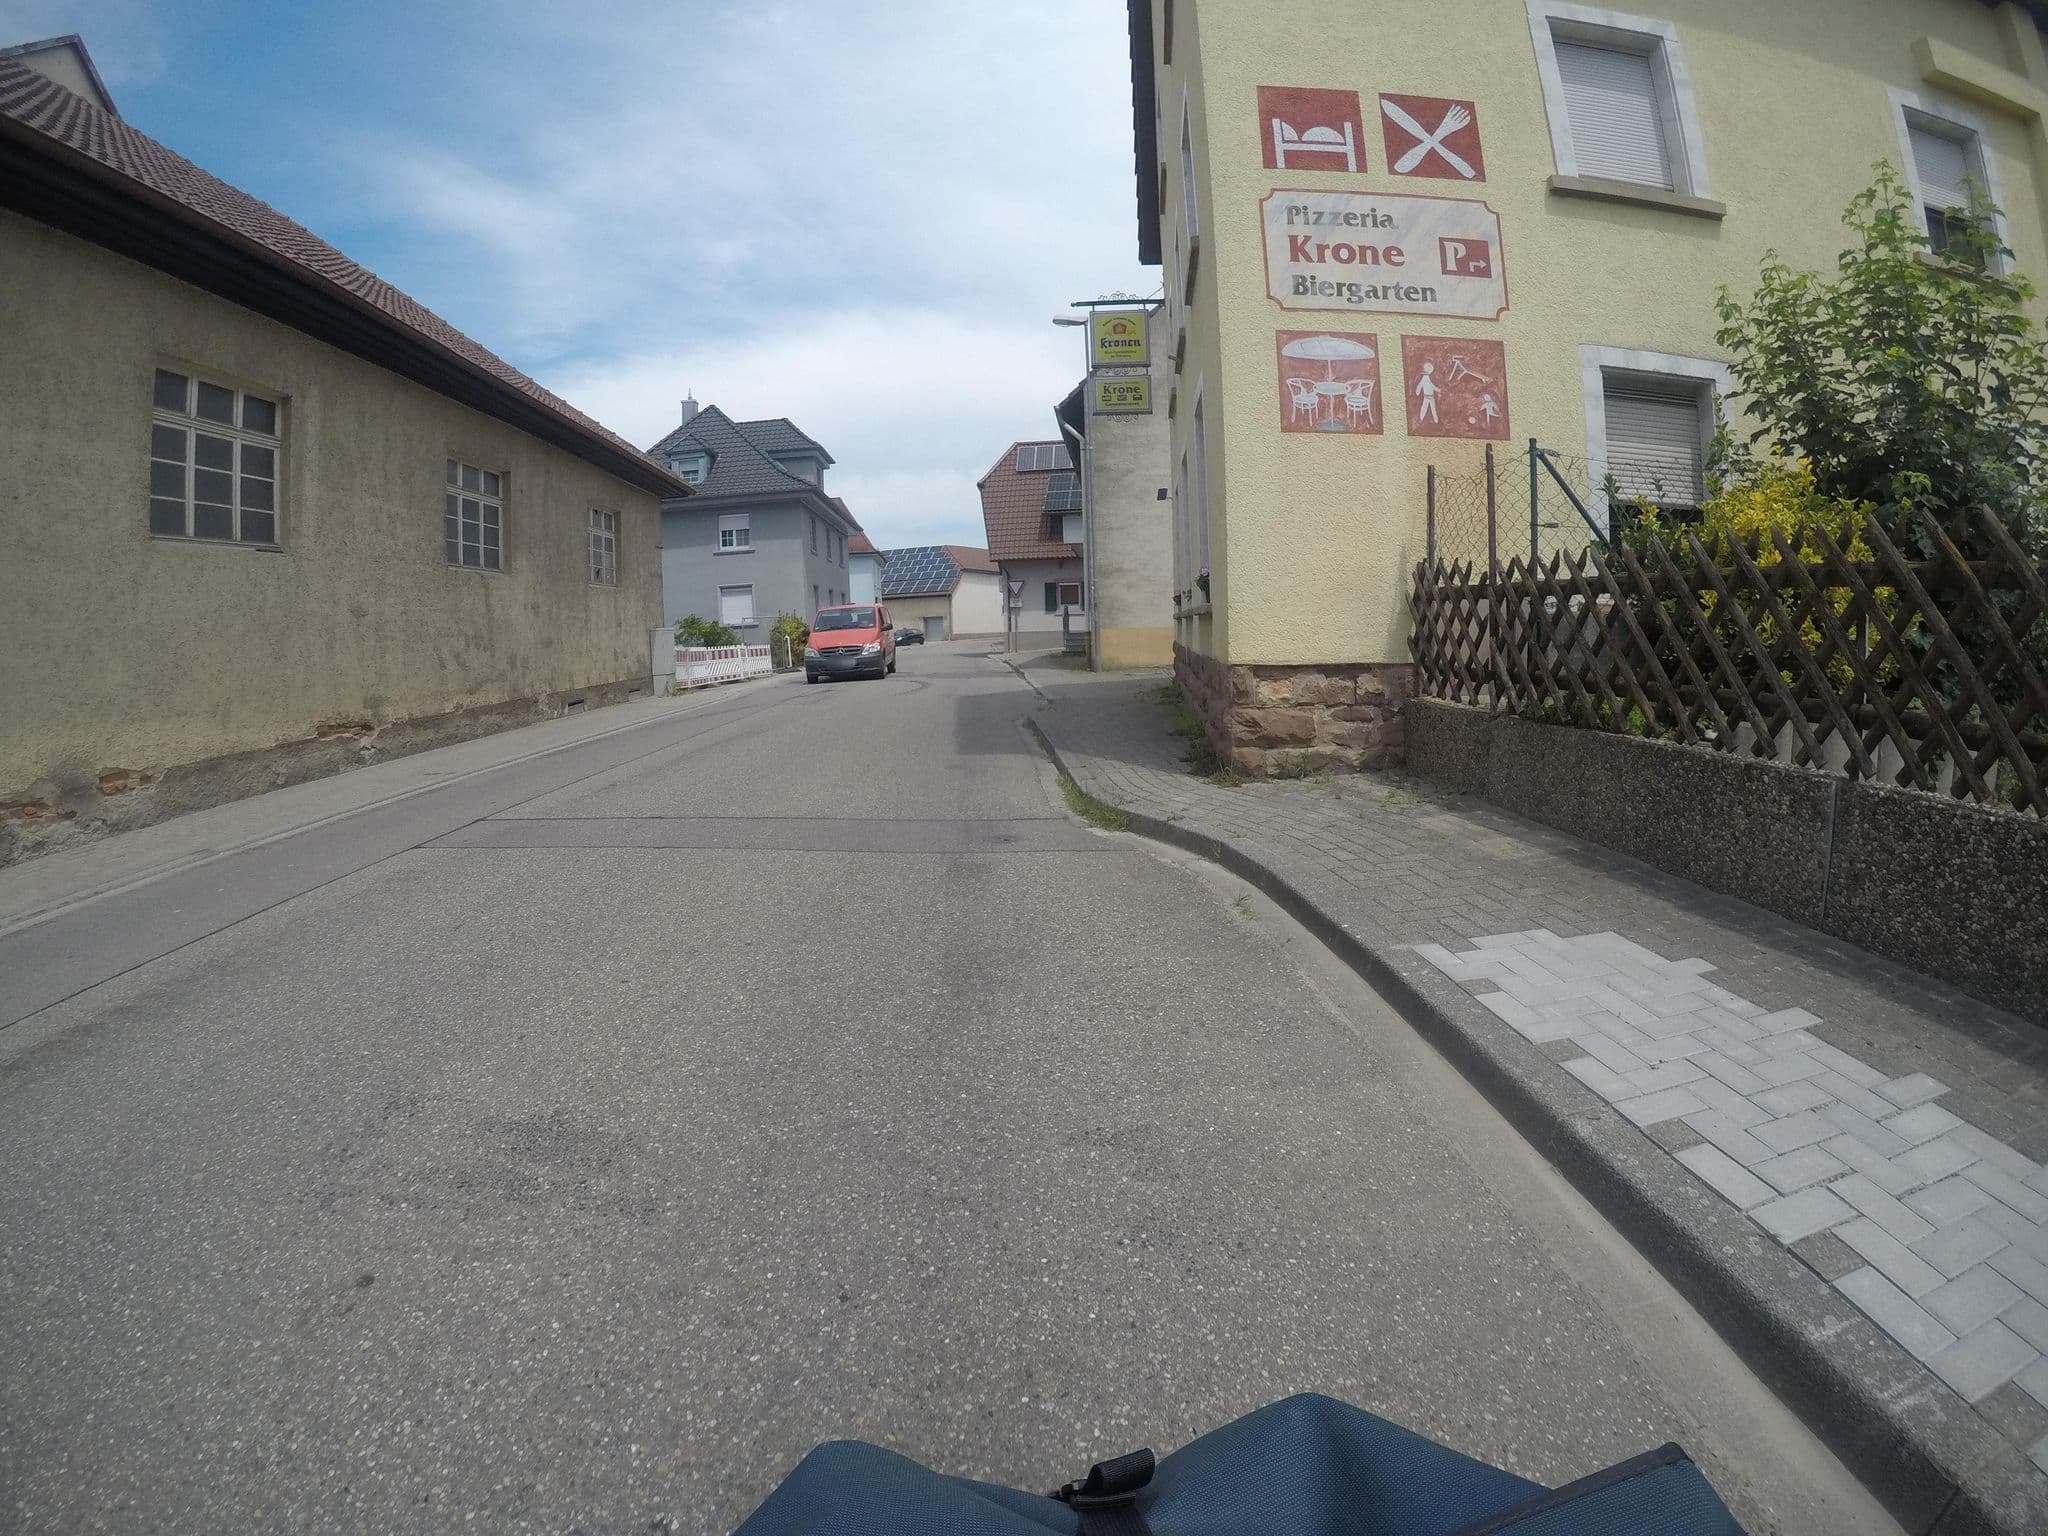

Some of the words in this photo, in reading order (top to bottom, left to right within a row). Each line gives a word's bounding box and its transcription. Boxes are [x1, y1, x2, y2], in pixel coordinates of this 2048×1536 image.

[1286, 205, 1396, 229] Pizzeria
[1288, 234, 1405, 267] Krone
[1443, 241, 1467, 271] P
[1292, 274, 1438, 304] Biergarten
[1103, 385, 1141, 394] Krone
